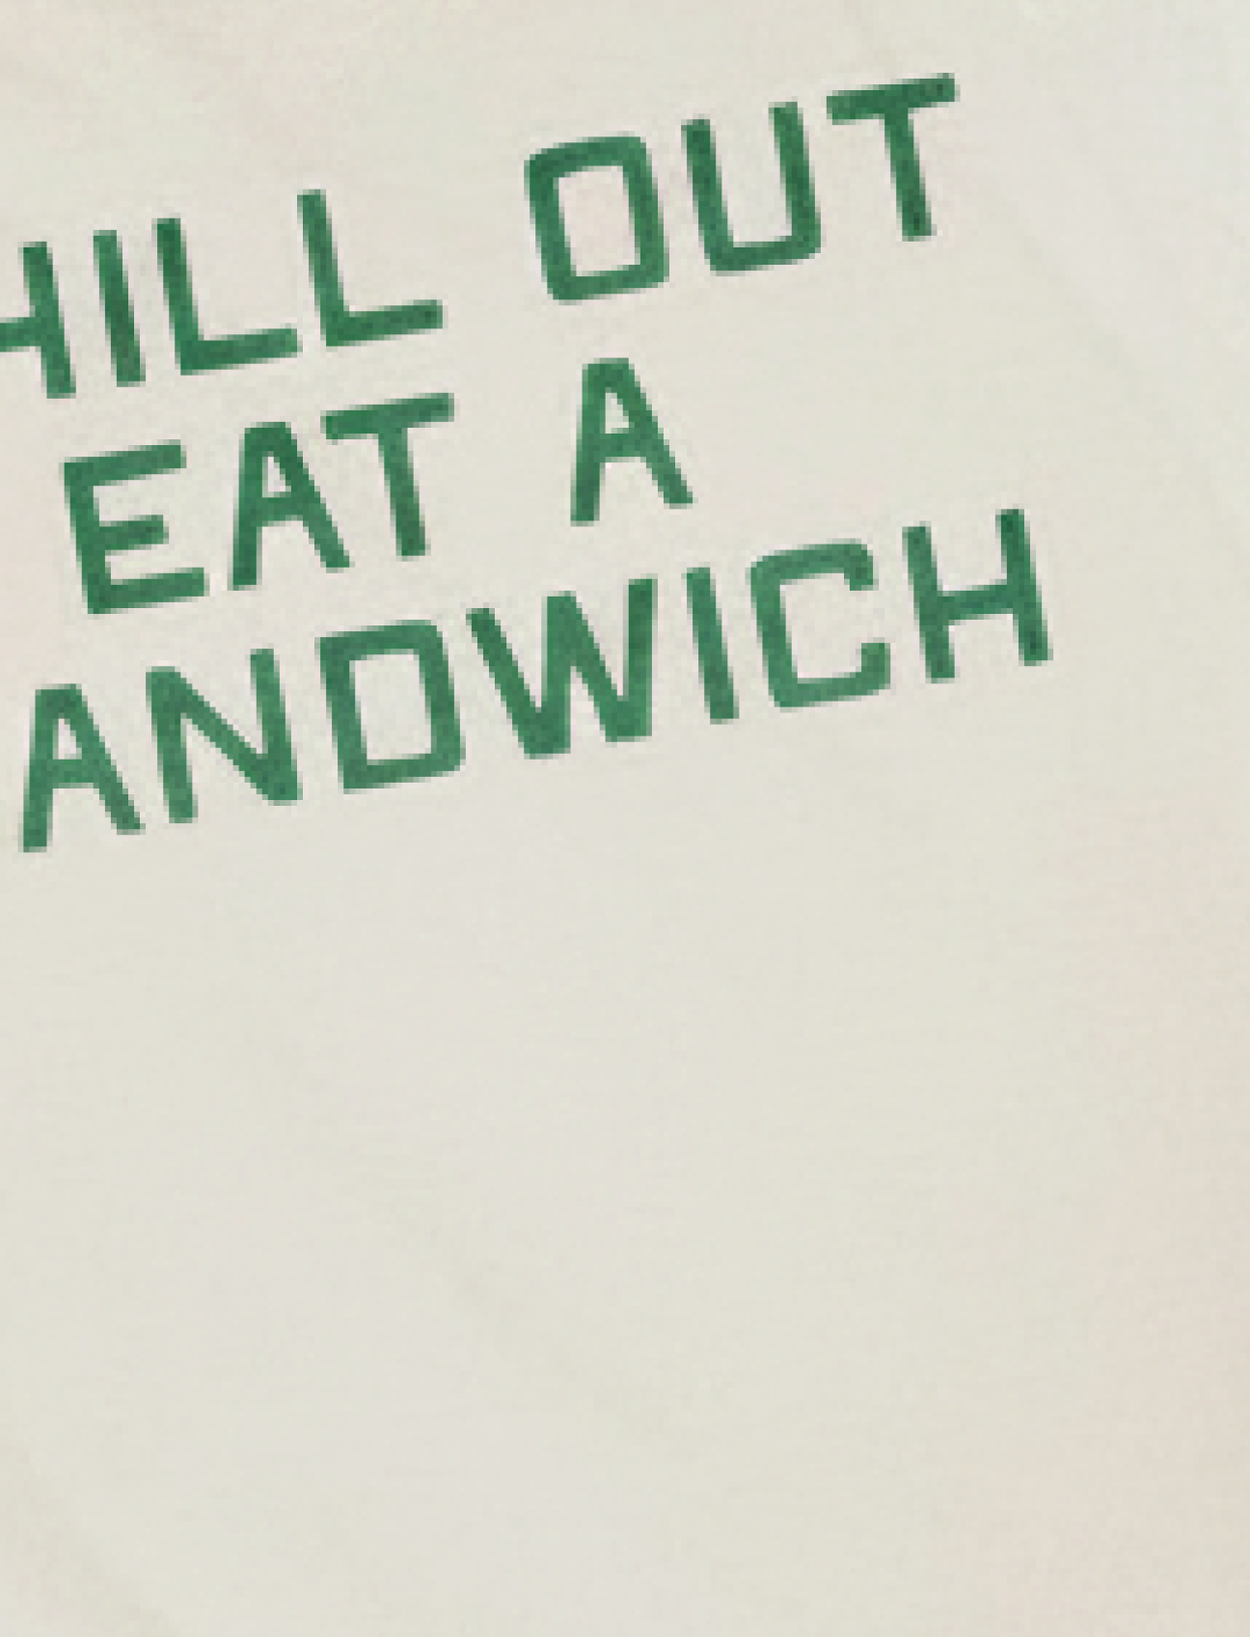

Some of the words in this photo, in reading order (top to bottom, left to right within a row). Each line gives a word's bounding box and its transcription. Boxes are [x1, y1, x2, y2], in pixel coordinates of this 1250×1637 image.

[524, 73, 956, 301] OUT
[64, 393, 455, 615] EAT
[571, 358, 694, 523] A
